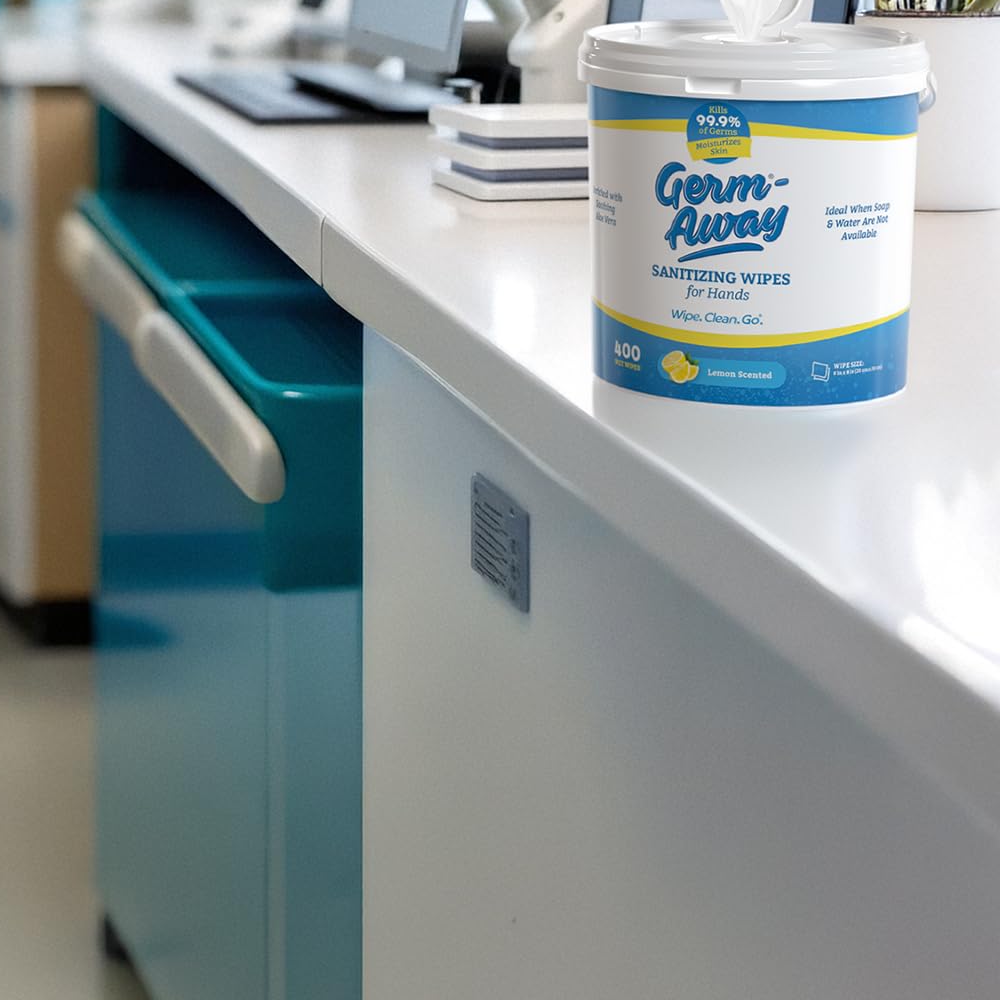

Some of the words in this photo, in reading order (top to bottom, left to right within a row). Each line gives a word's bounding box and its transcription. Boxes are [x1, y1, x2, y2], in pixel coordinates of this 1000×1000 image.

[709, 105, 728, 114] Kills
[696, 114, 741, 127] 99.9%
[709, 128, 738, 136] Germs
[696, 139, 741, 150] Moisturizes
[710, 147, 728, 155] Skin
[825, 205, 848, 215] Ideal
[850, 203, 872, 213] When
[874, 202, 890, 212] Soap
[664, 205, 789, 250] Away
[826, 219, 833, 228] &
[835, 219, 861, 228] Water
[862, 217, 876, 226] Are
[876, 215, 889, 224] Not
[841, 228, 877, 241] Available
[652, 264, 736, 284] SANITIZING
[740, 272, 791, 286] WIPES
[685, 284, 704, 299] for
[707, 287, 750, 301] Hands
[671, 309, 702, 322] Wipe.
[704, 312, 740, 324] Clean.
[615, 340, 641, 361] 400
[707, 369, 736, 378] Lemon
[738, 370, 772, 379] Scented
